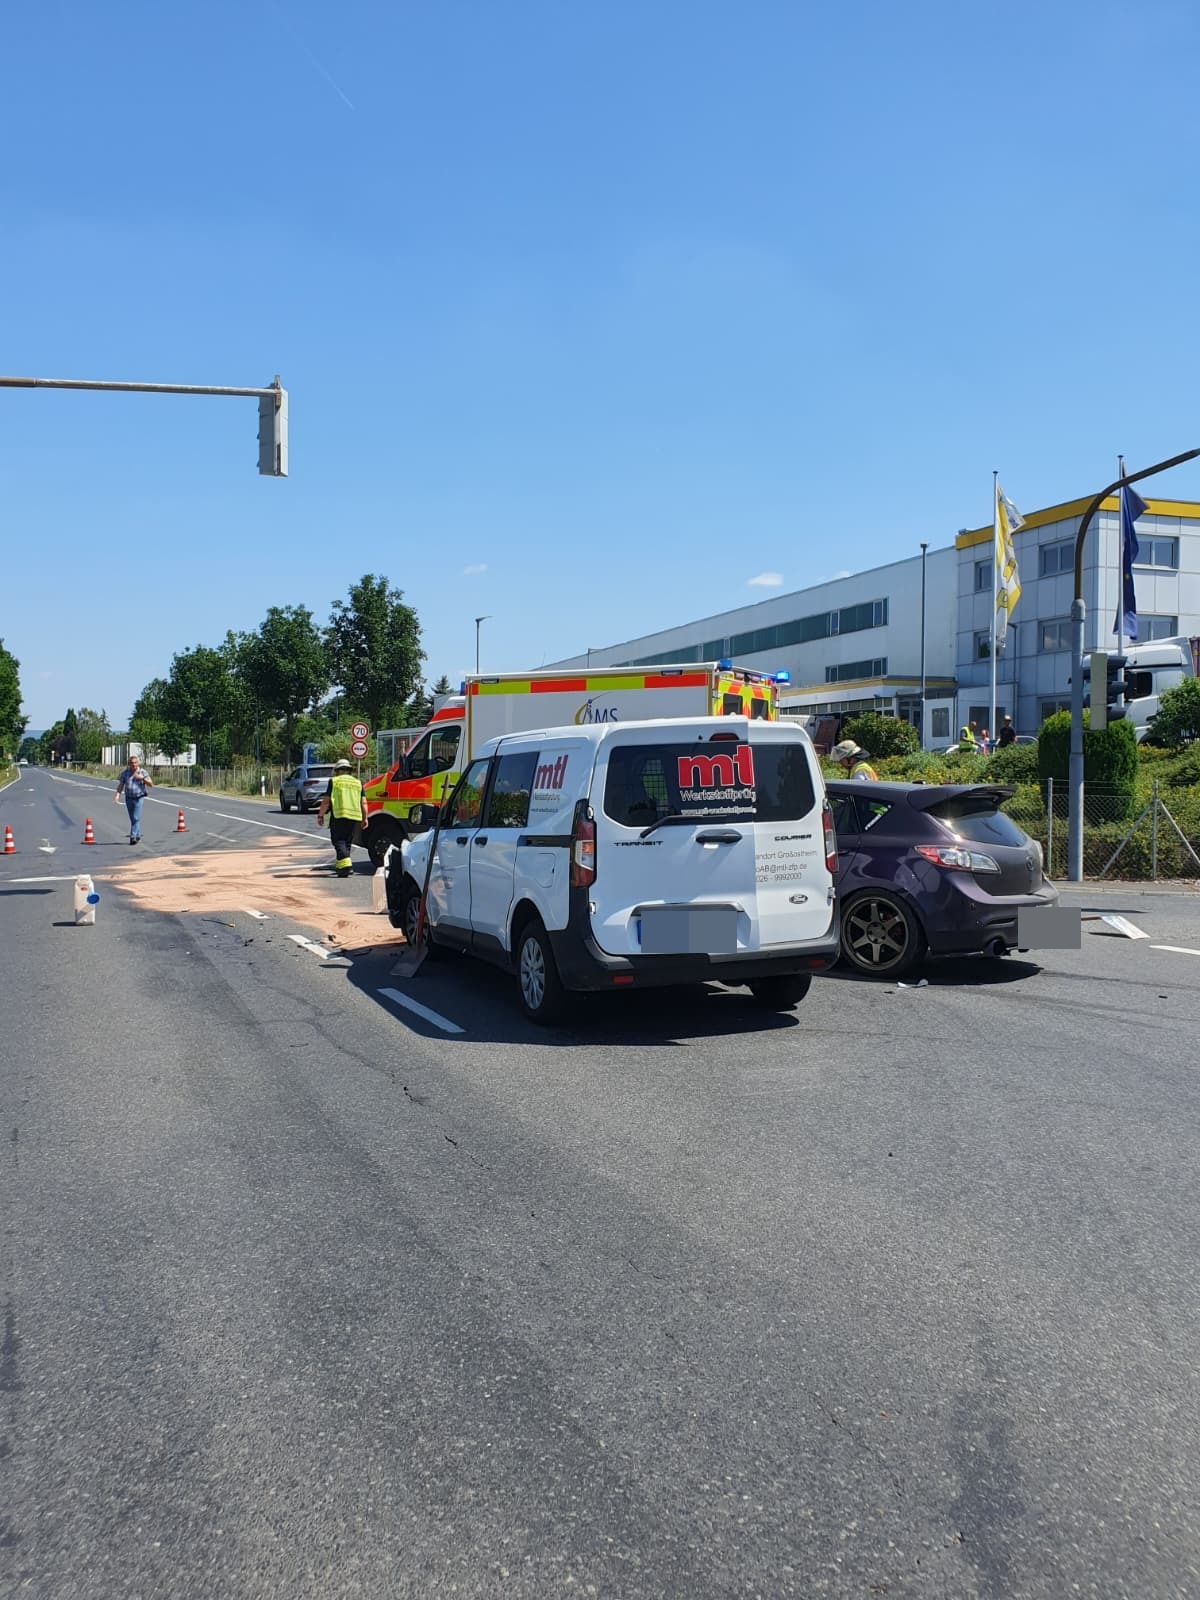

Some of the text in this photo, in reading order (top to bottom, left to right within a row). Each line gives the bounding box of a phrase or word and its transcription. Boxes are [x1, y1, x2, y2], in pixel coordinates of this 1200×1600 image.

[355, 727, 365, 736] 70
[534, 754, 569, 789] mtl
[774, 834, 812, 842] COURIER
